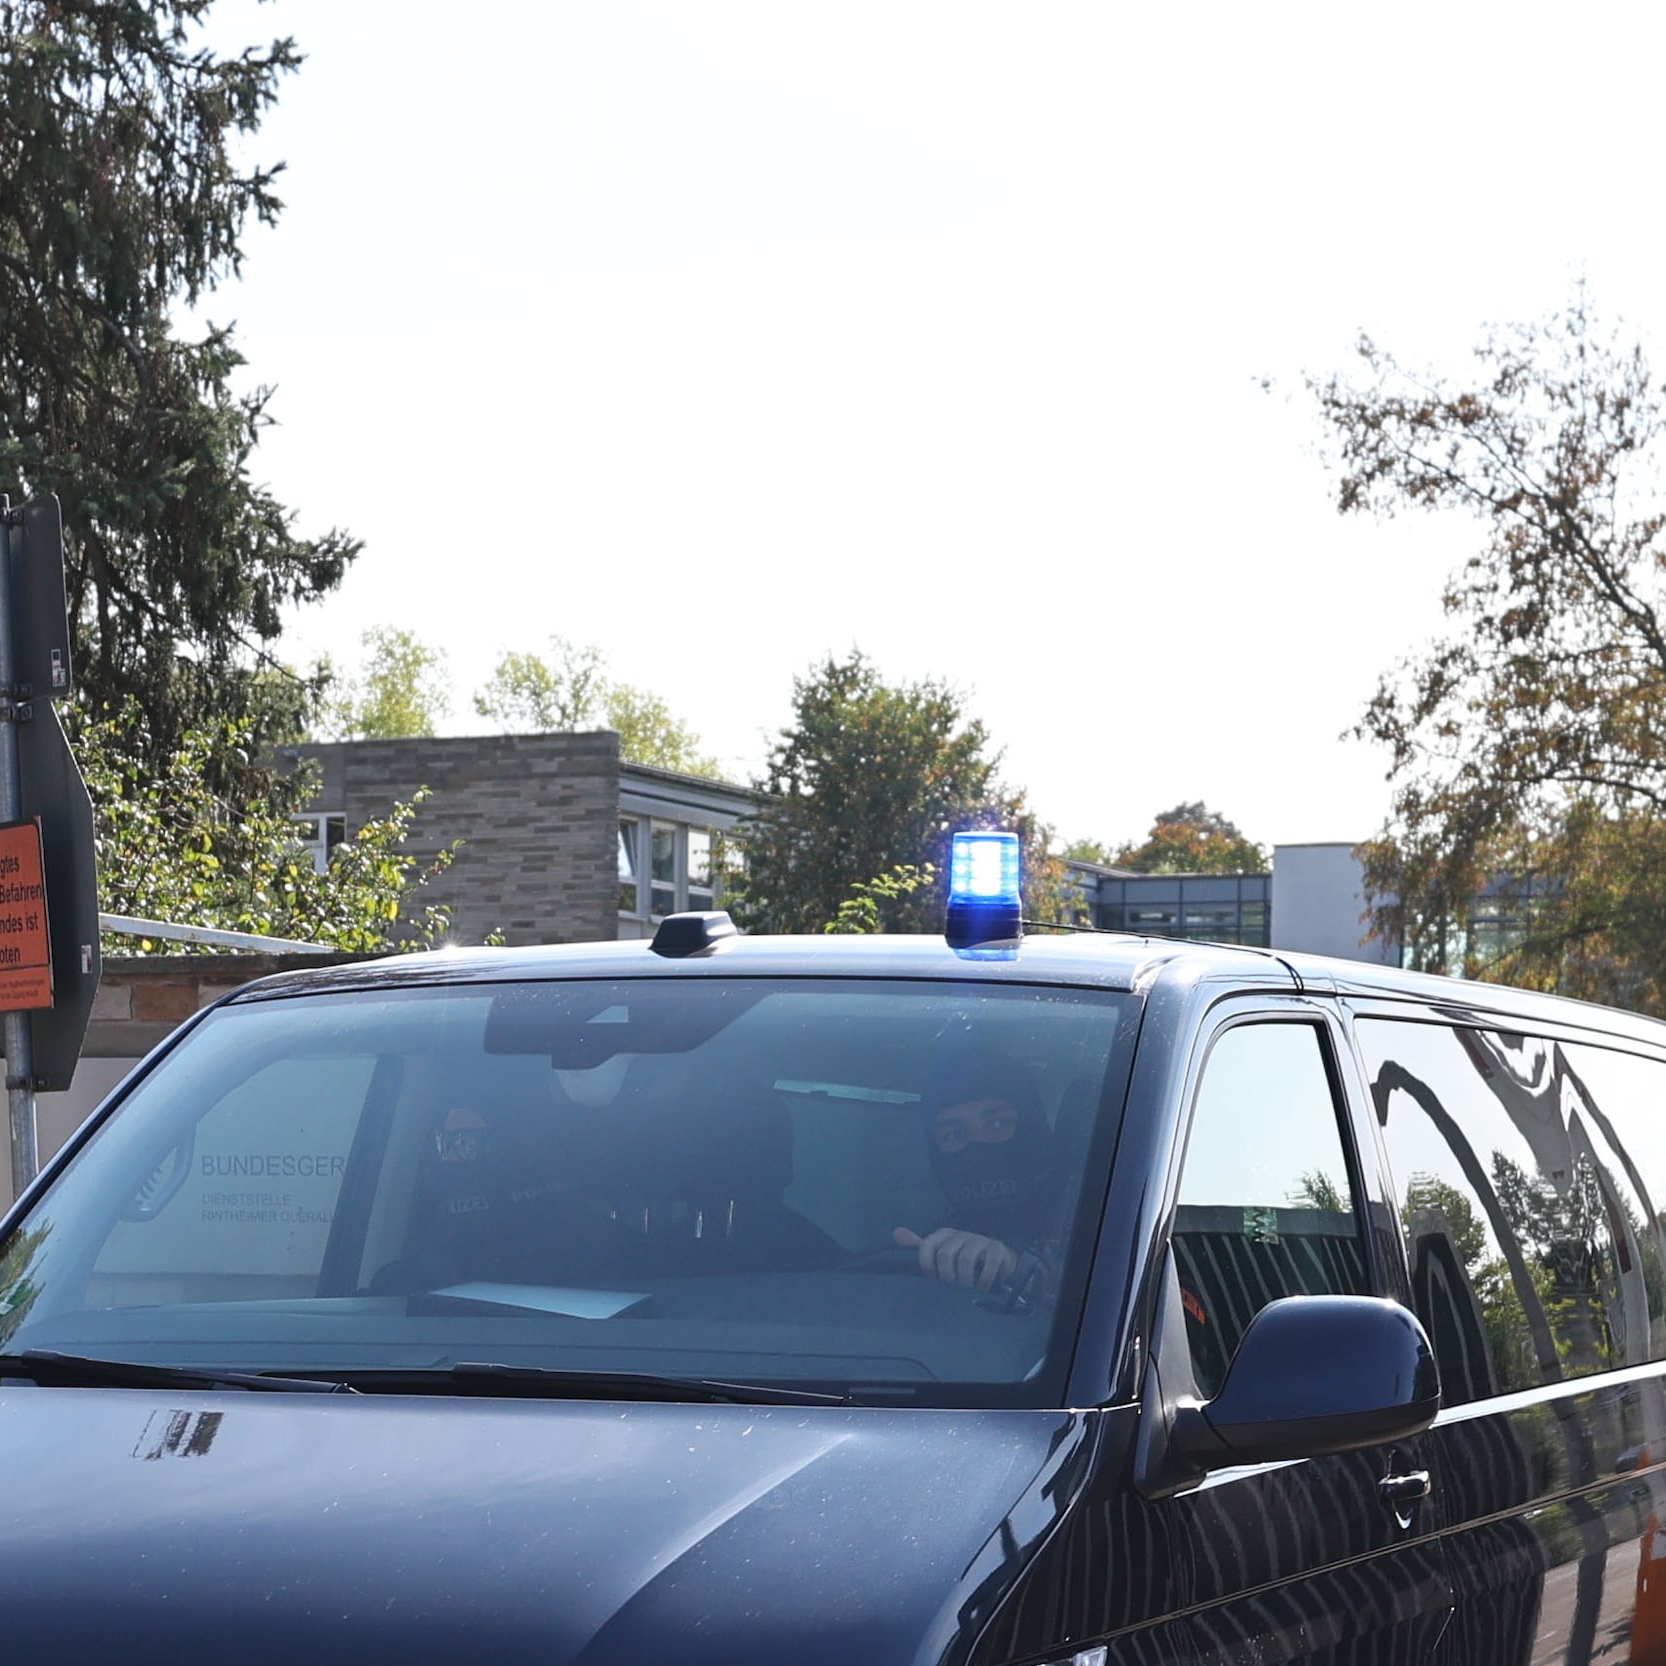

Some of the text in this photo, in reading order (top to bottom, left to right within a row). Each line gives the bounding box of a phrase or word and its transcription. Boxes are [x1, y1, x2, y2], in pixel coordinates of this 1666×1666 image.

[25, 911, 39, 931] ist
[201, 1154, 345, 1177] BUNDESGER
[201, 1192, 293, 1207] DIENSTSTELLE
[201, 1208, 277, 1223] RINTHEIMER
